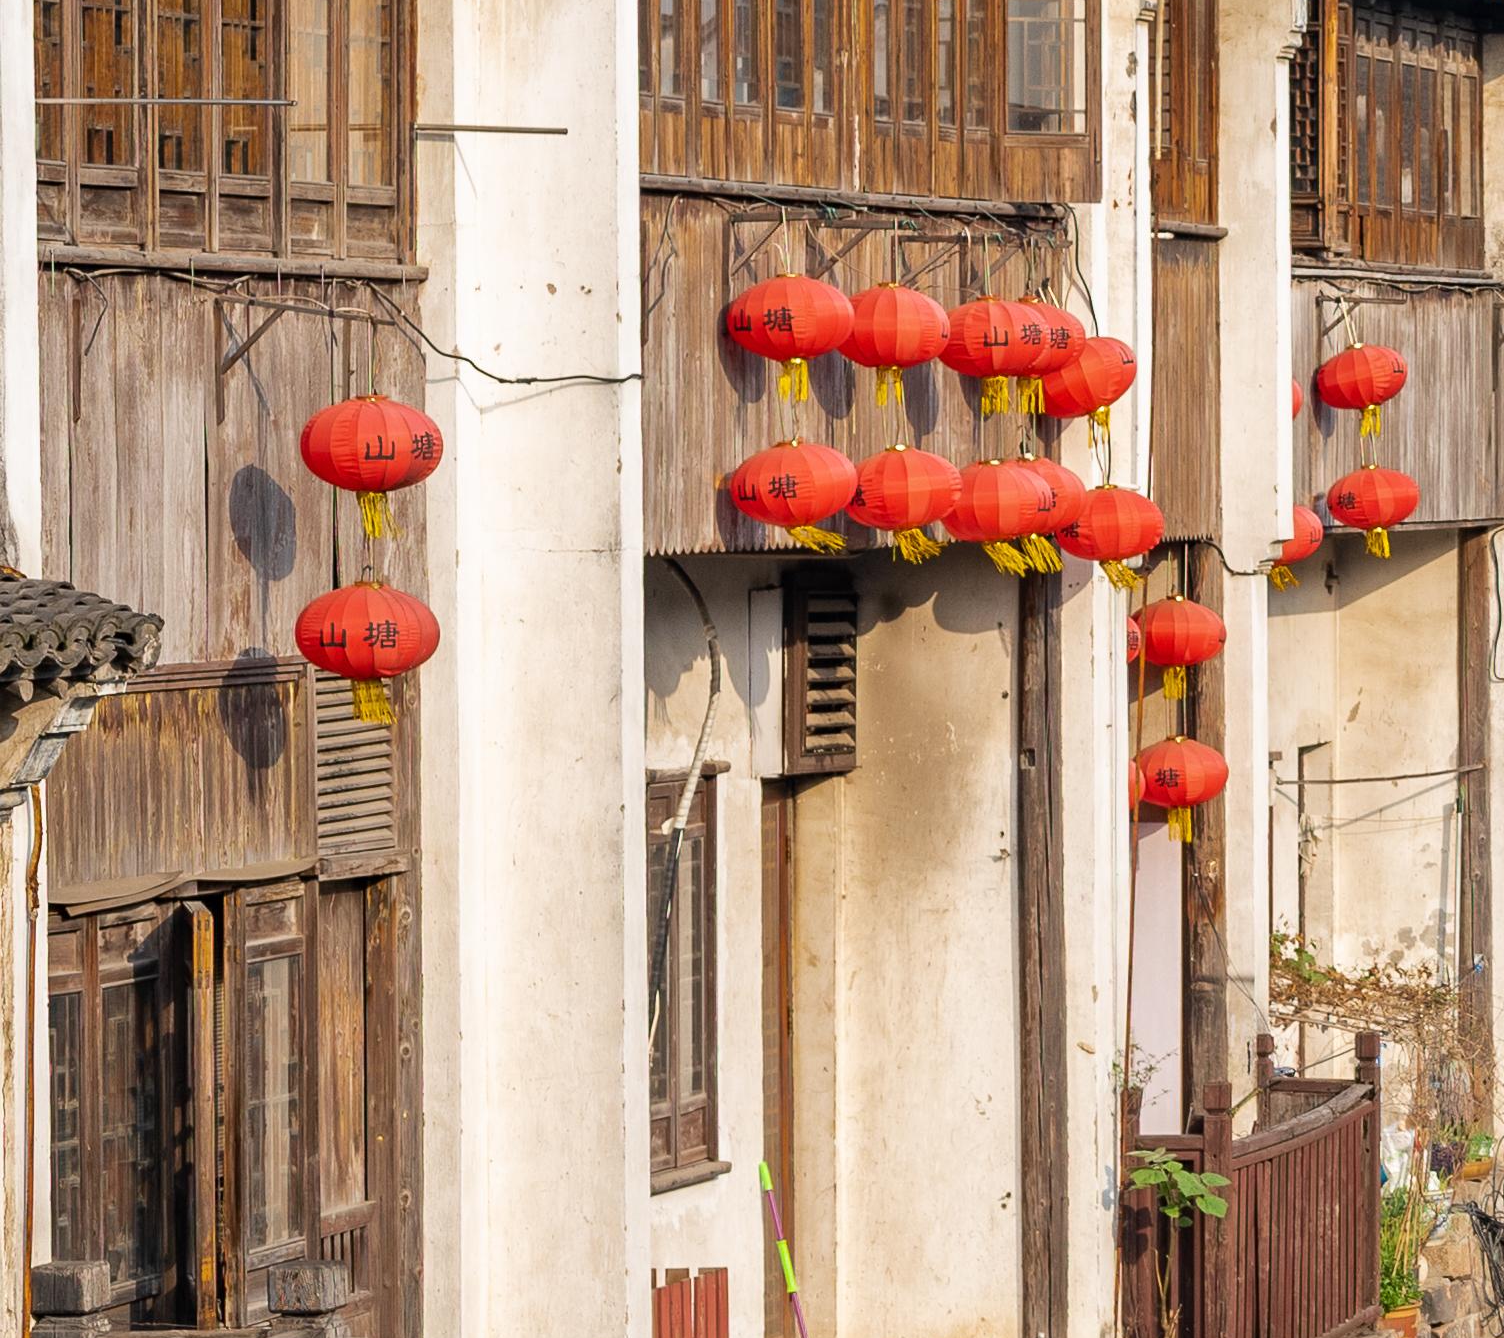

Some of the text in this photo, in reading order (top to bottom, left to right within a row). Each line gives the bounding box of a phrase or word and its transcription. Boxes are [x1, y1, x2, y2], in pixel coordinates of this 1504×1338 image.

[733, 306, 795, 333] 山塘
[983, 324, 1043, 348] 山塘
[364, 431, 435, 461] 山塘
[738, 473, 799, 502] 山塘
[320, 620, 400, 650] 山塘
